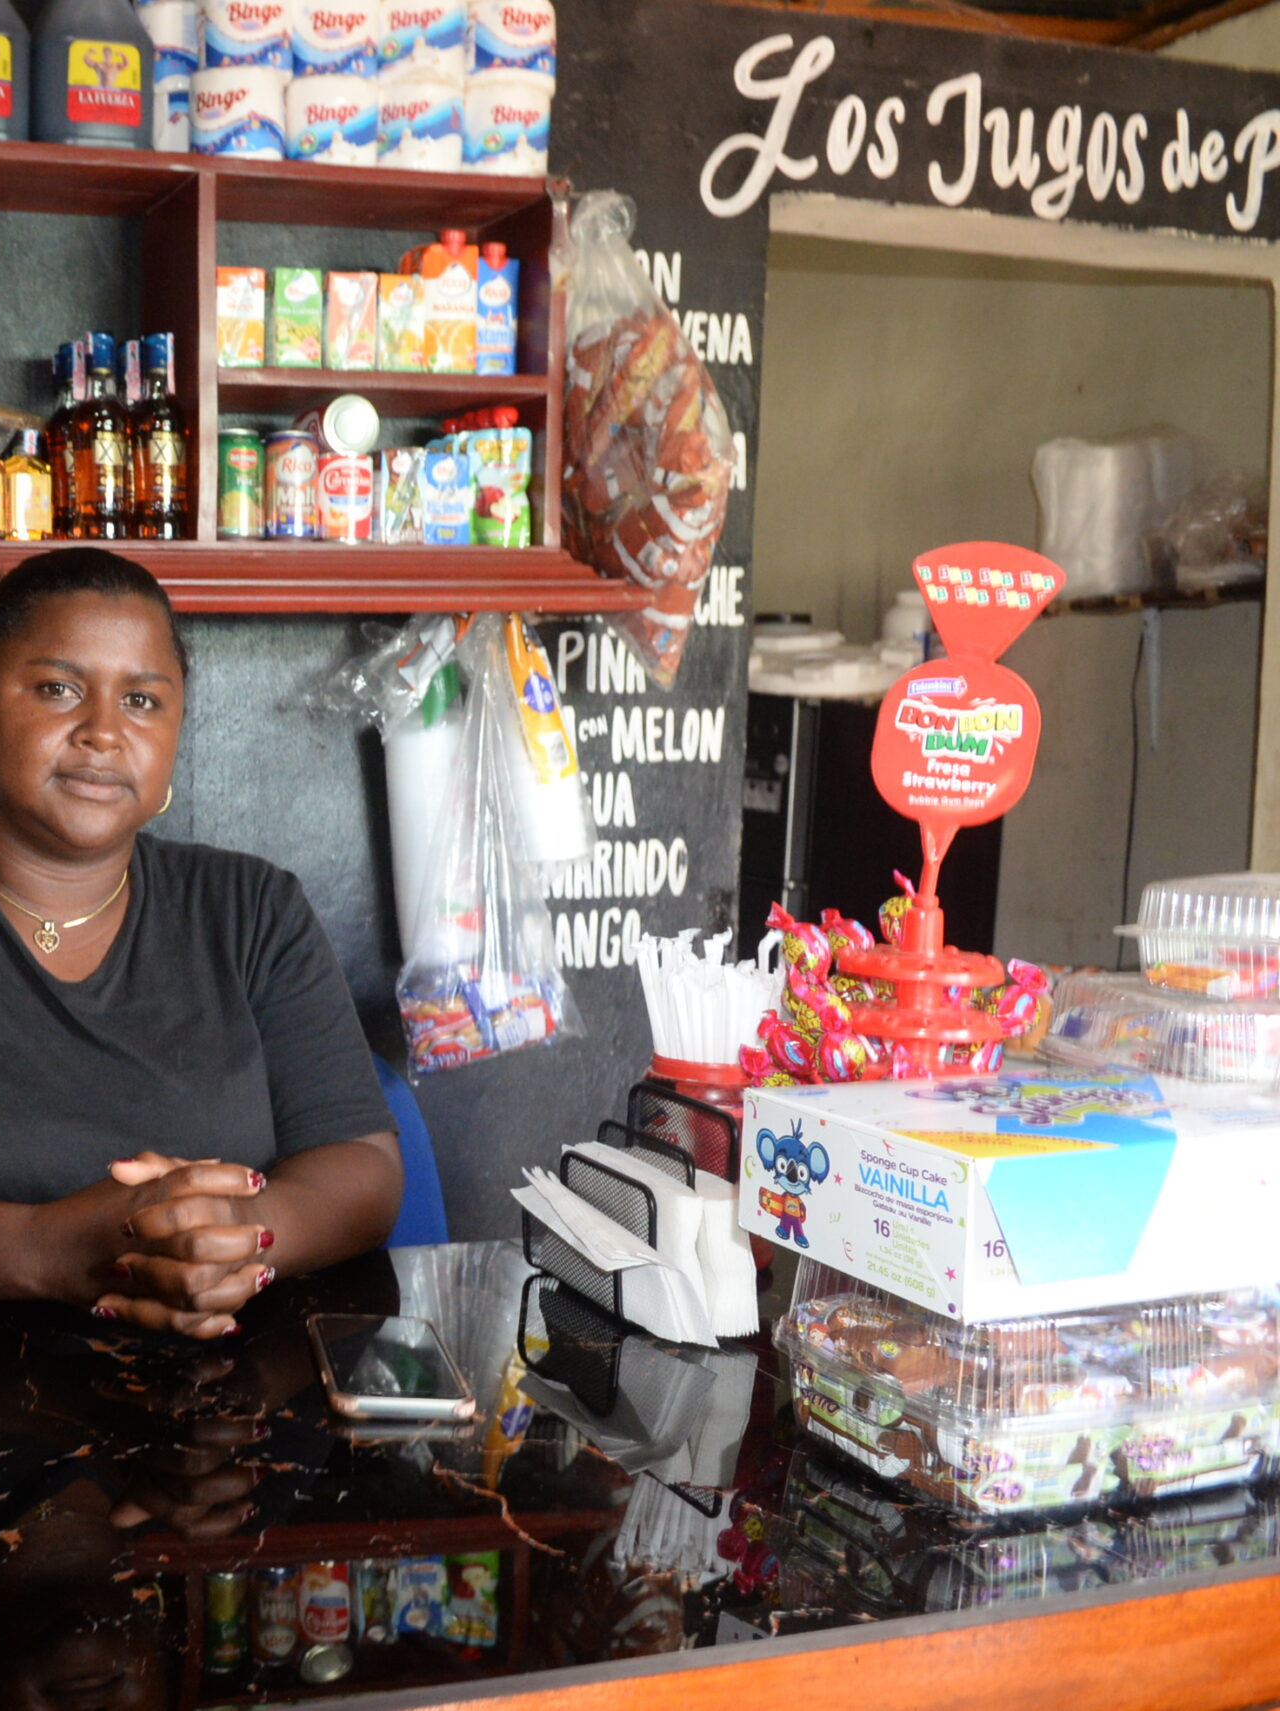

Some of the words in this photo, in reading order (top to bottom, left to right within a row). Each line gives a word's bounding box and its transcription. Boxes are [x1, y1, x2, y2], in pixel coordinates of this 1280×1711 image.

[227, 2, 284, 26] Bingo
[312, 8, 367, 32] Bingo
[388, 5, 445, 29] Bingo
[499, 7, 553, 31] Bingo
[94, 91, 135, 108] FUERZA
[195, 88, 249, 113] Bingo
[305, 103, 359, 127] Bingo
[380, 100, 433, 124] Bingo
[490, 104, 542, 128] Bingo
[700, 33, 907, 218] Los
[926, 71, 1149, 221] Jugos
[1160, 107, 1229, 194] de
[1225, 107, 1280, 232] P
[899, 705, 957, 732] BON
[958, 710, 1019, 734] BON
[611, 704, 726, 764] MELON
[926, 758, 972, 778] Fresa
[902, 770, 998, 798] Strawberry
[581, 771, 637, 828] UA
[552, 906, 642, 970] ANGO
[860, 1149, 897, 1171] Sponge
[899, 1162, 919, 1179] Cup
[921, 1169, 948, 1187] Cake
[858, 1163, 950, 1213] VAINILLA
[854, 1183, 885, 1201] Bizcocho
[896, 1198, 915, 1212] masa
[916, 1204, 954, 1225] esponjosa
[873, 1217, 891, 1239] 16
